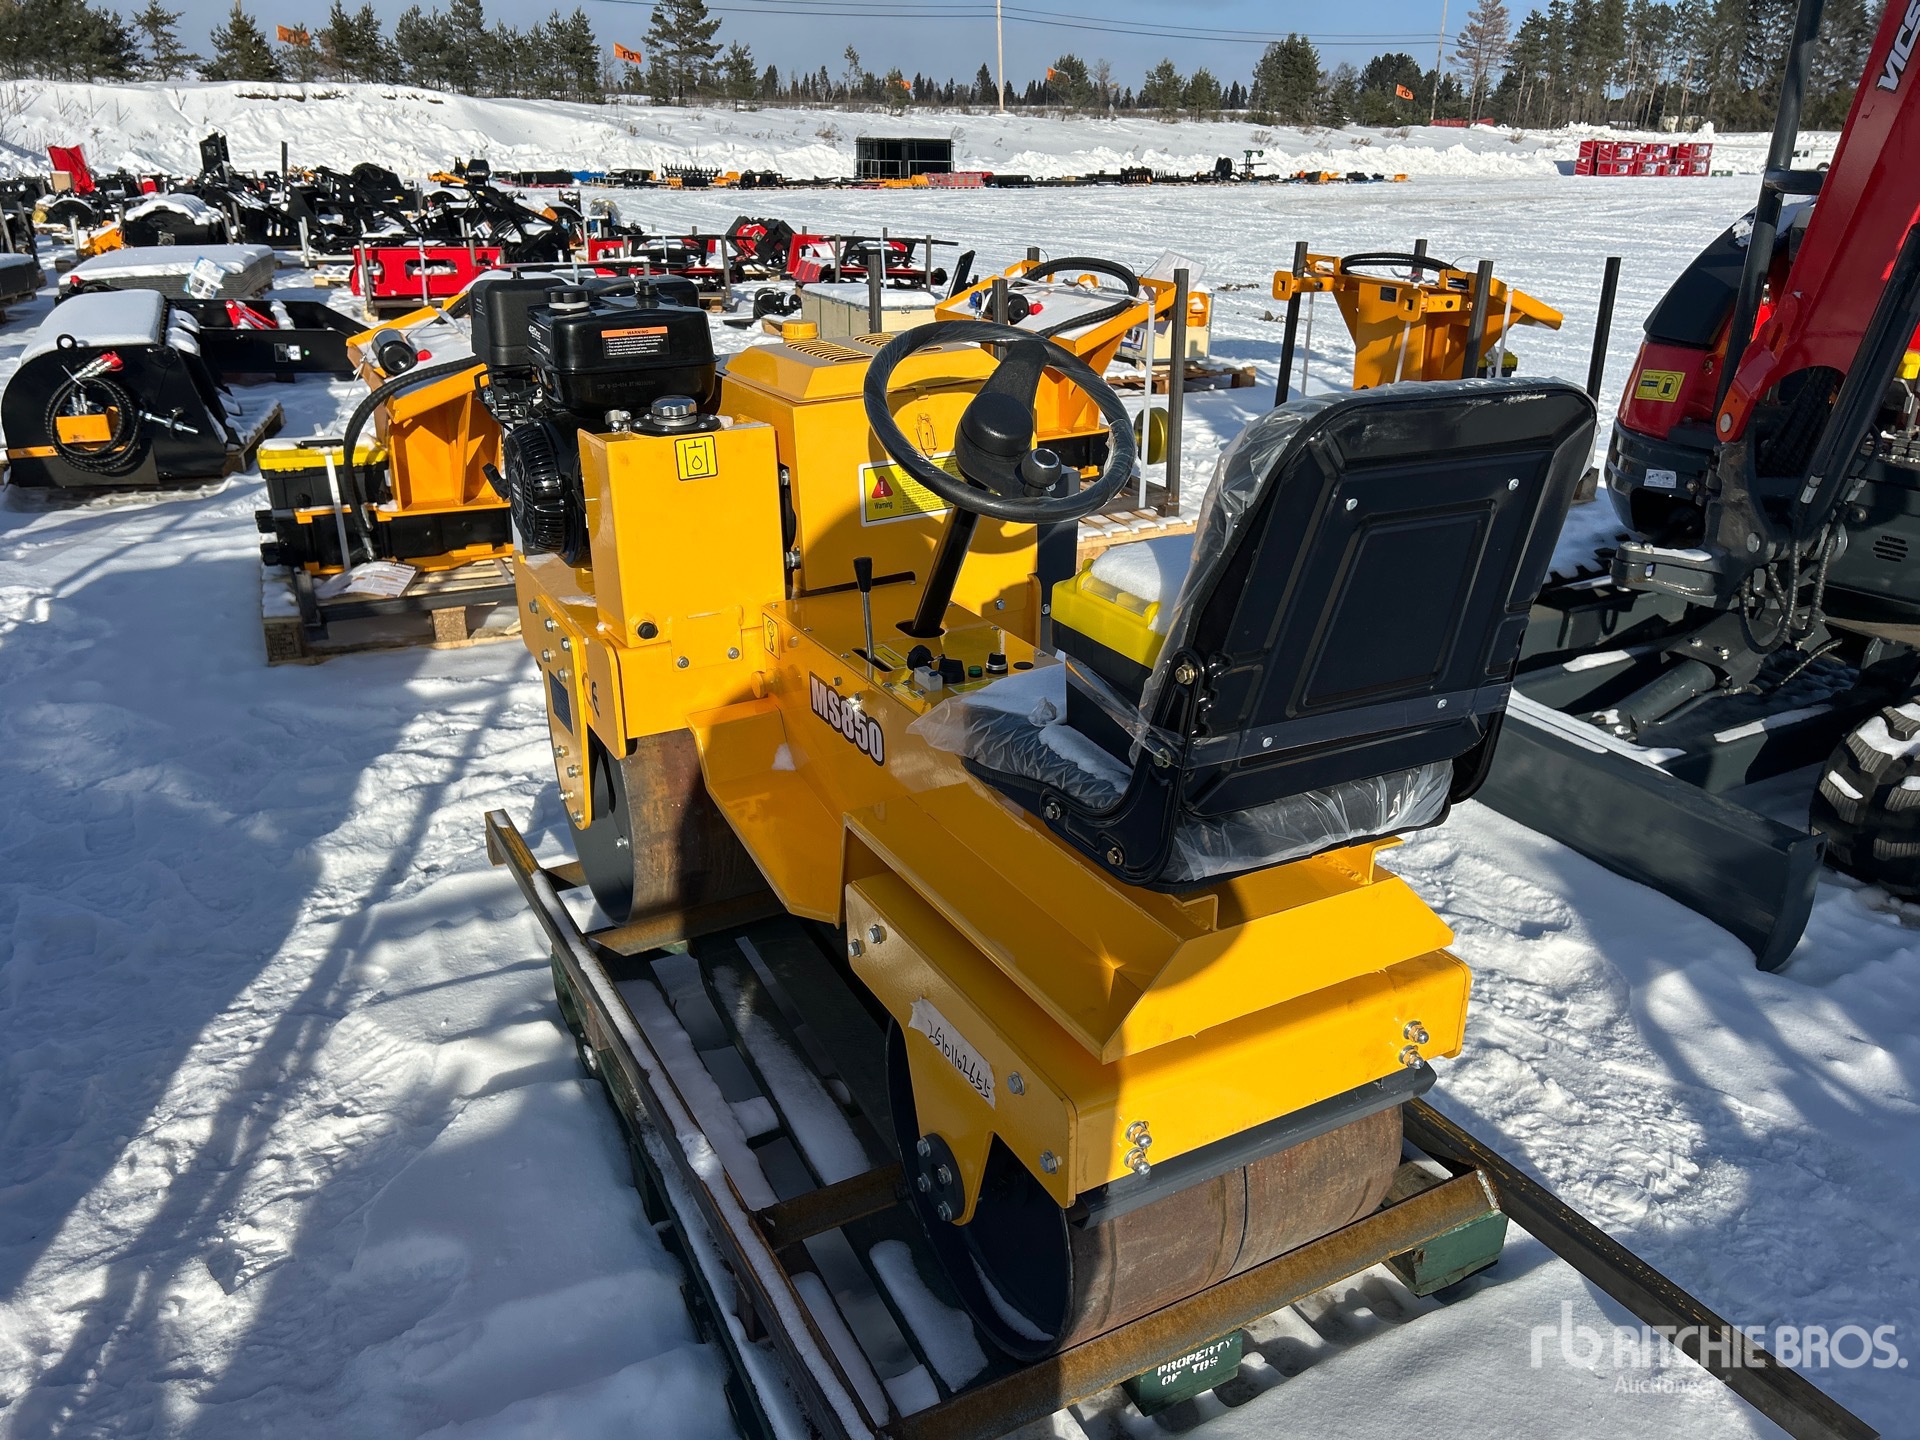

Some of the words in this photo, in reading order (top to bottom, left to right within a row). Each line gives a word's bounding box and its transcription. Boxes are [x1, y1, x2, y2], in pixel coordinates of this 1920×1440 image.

[874, 501, 893, 510] Warning
[809, 671, 885, 767] MS850
[1157, 1338, 1233, 1376] PROPERTY
[1161, 1370, 1182, 1386] OF
